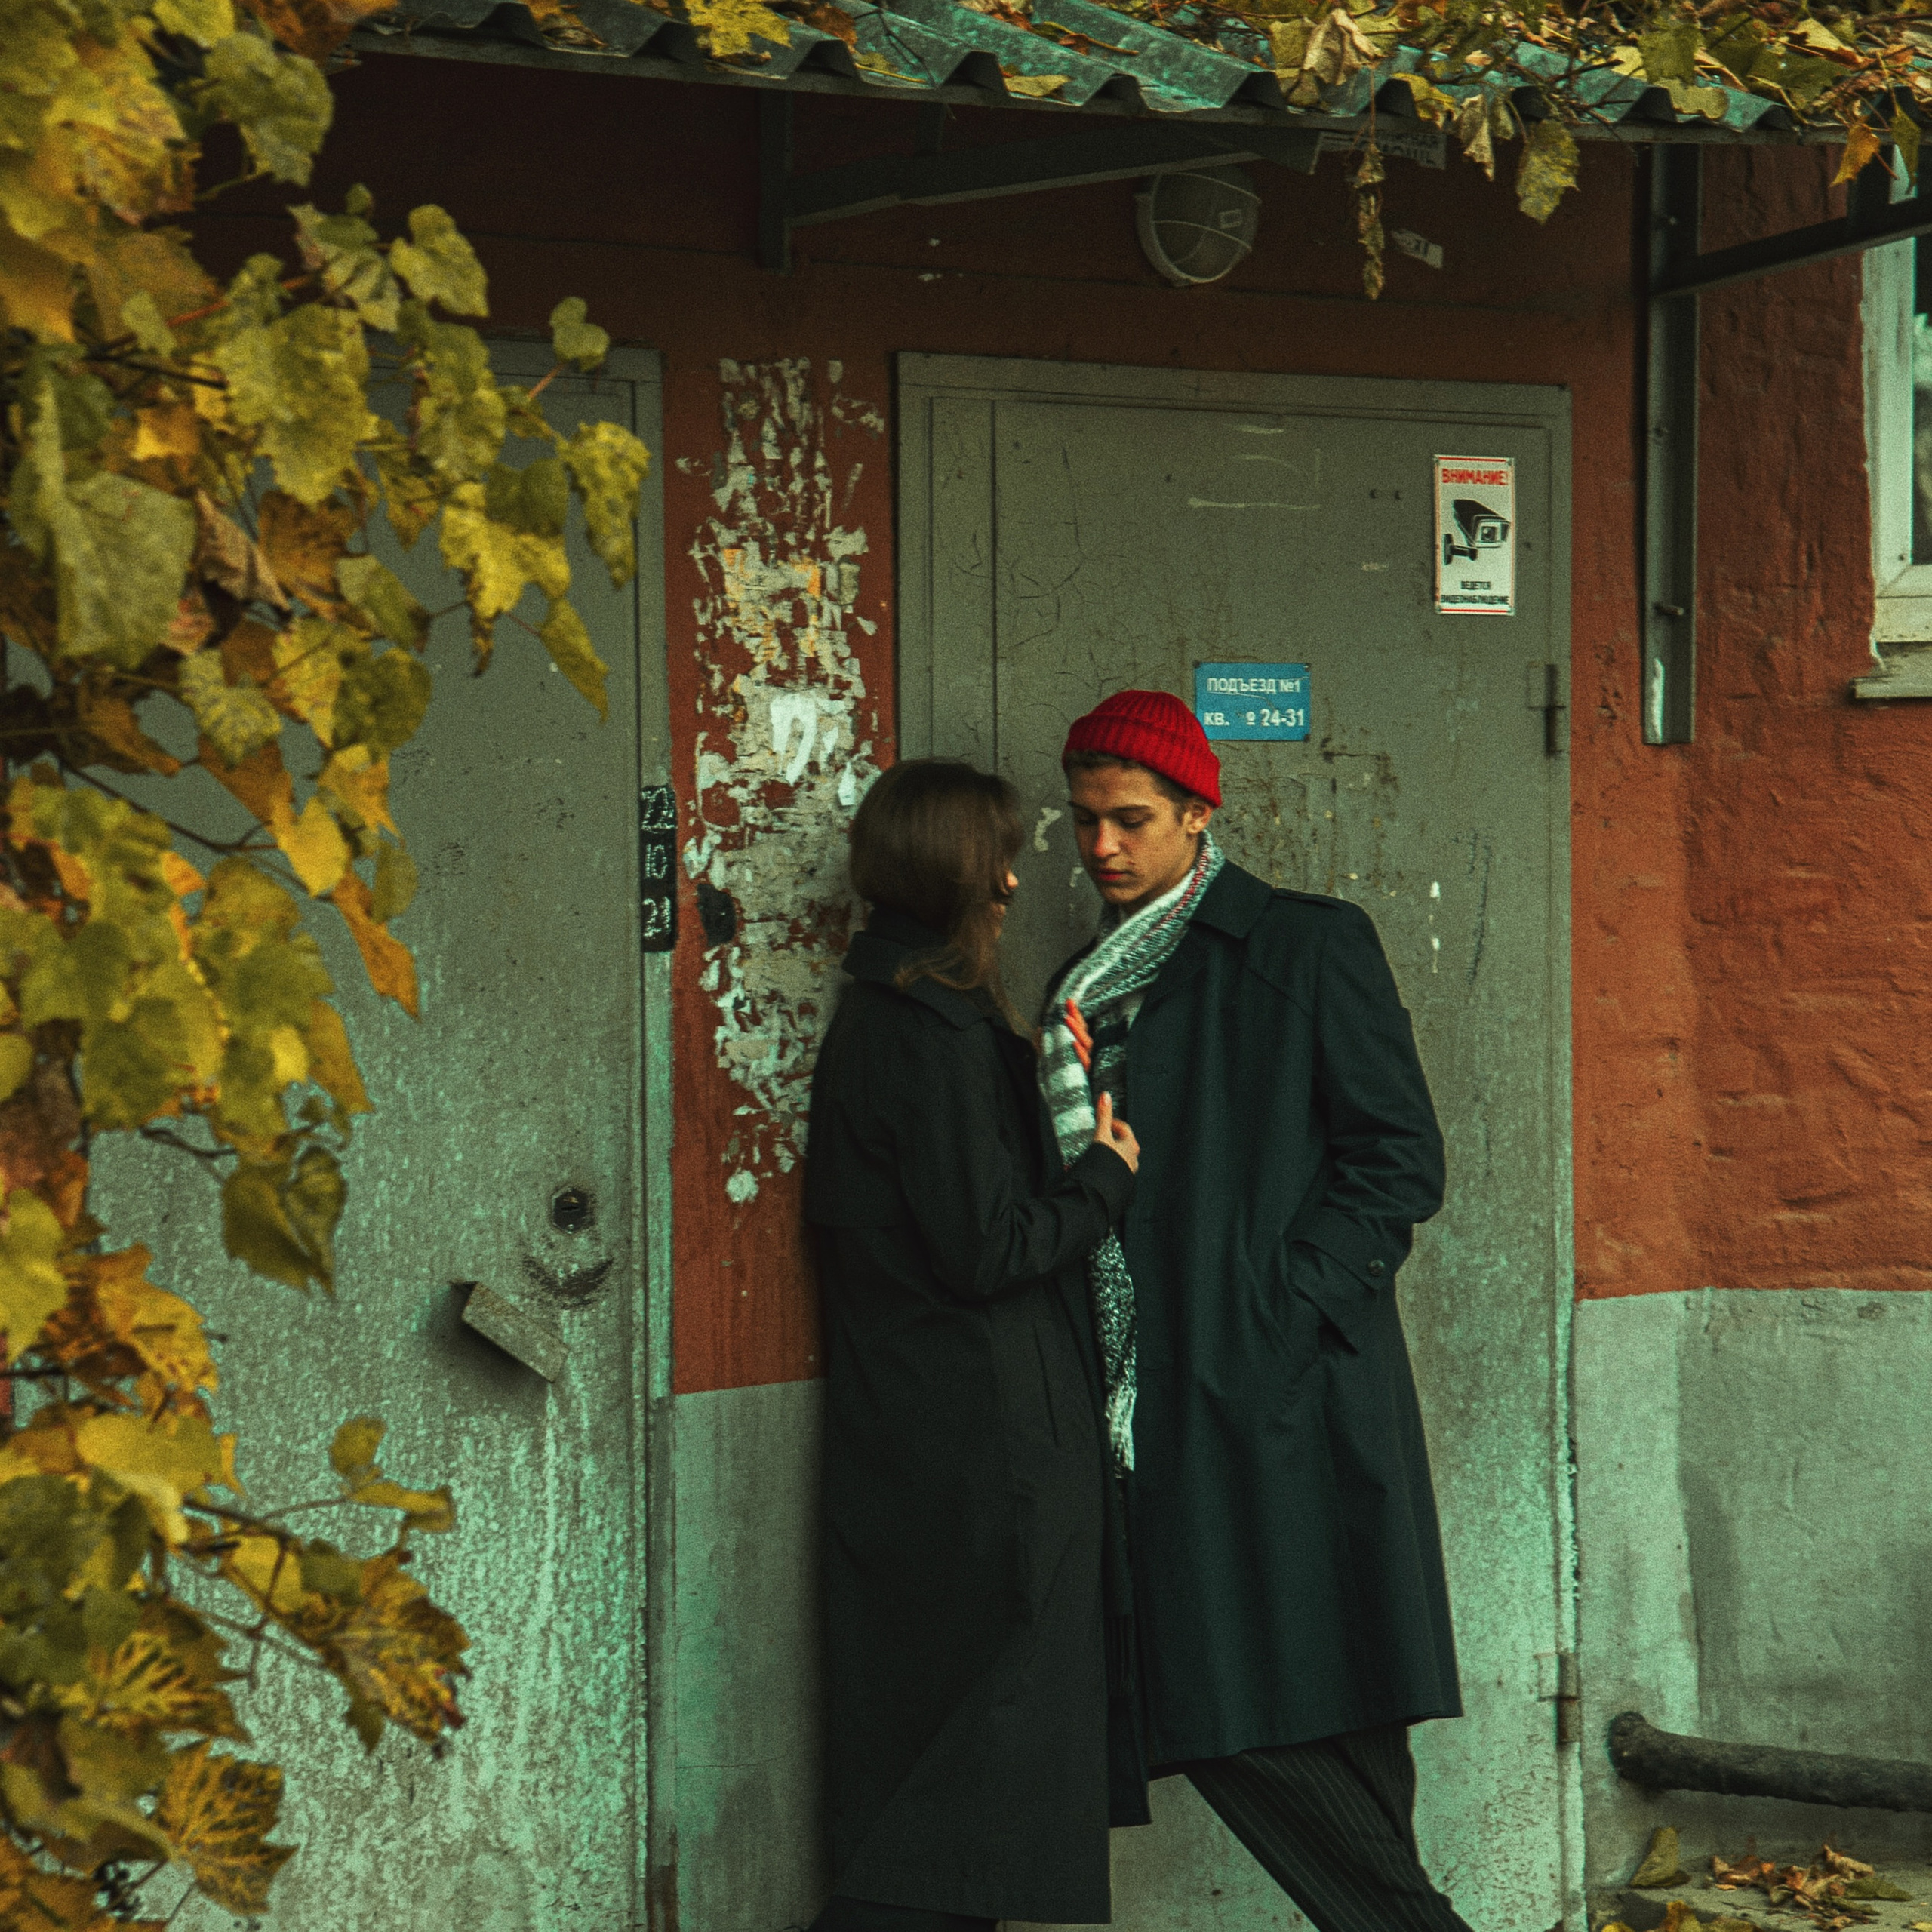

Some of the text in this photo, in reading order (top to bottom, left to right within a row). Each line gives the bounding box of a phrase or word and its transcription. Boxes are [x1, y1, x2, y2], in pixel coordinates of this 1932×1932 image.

[1441, 469, 1509, 485] ВНИМАНИЕ!
[1206, 677, 1300, 694] ПОДЪЕЗД №1
[1260, 708, 1305, 727] 24-31
